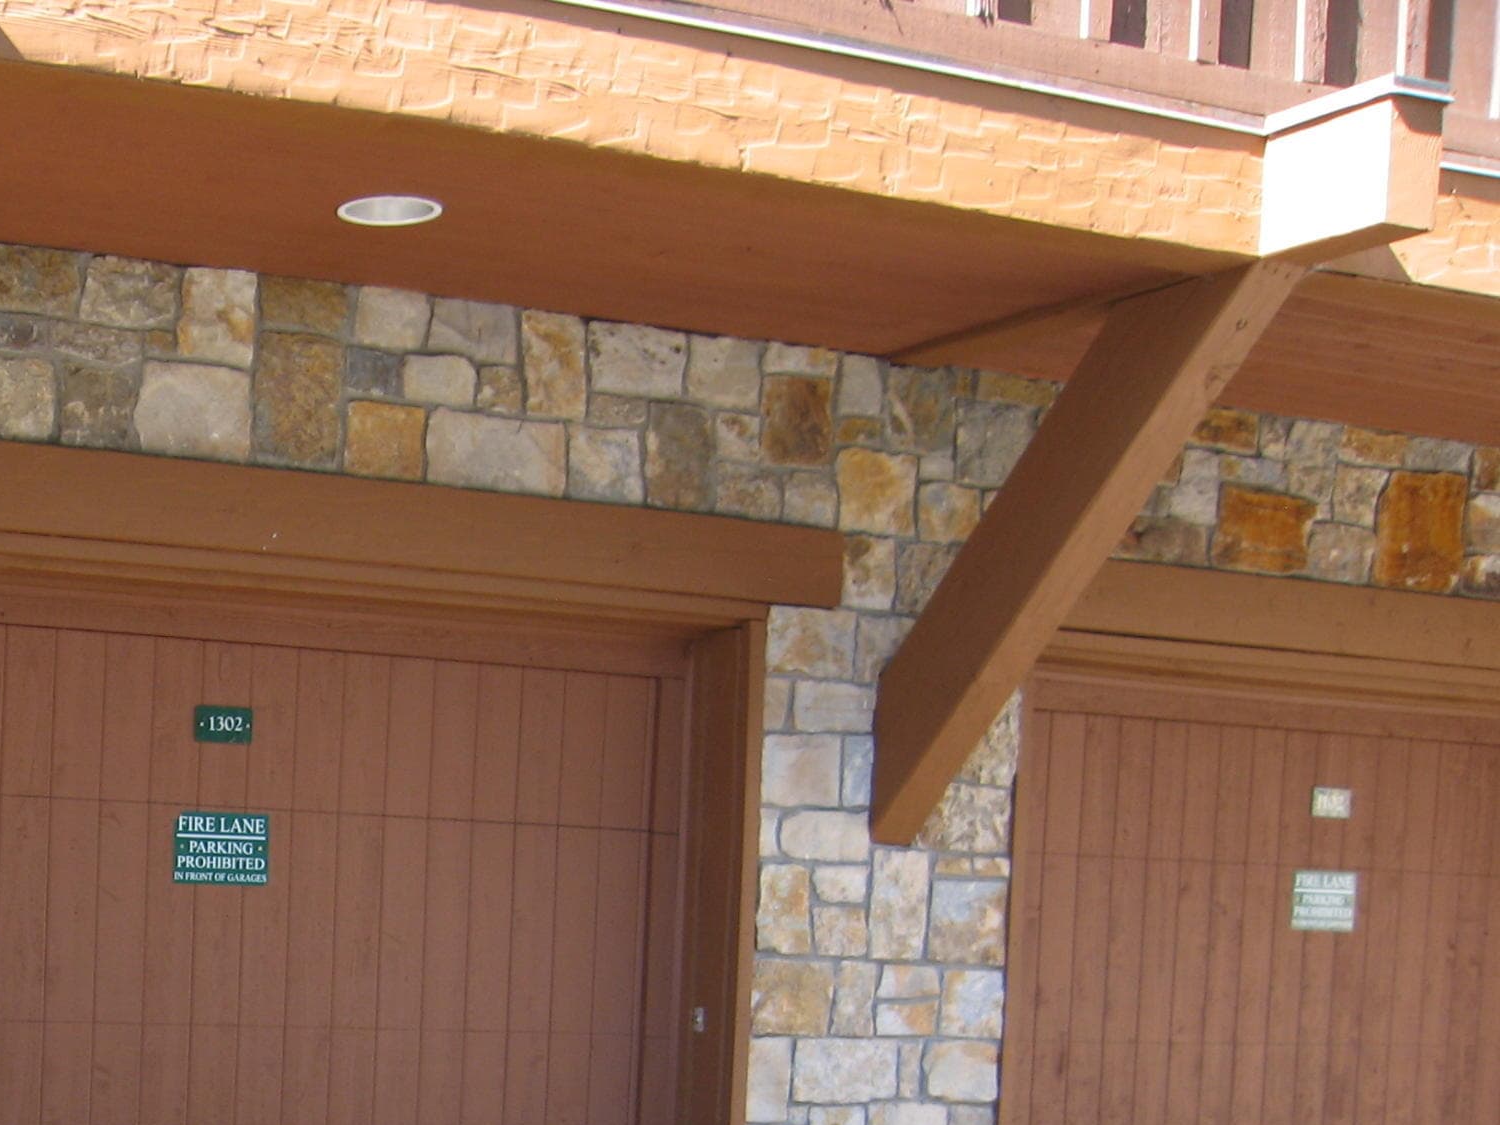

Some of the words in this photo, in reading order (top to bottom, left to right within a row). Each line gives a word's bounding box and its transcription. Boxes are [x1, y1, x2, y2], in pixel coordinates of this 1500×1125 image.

[208, 716, 243, 732] 1302
[178, 815, 216, 832] FIRE
[220, 818, 265, 834] LANE
[189, 840, 253, 855] PARKING
[177, 855, 265, 871] PROHIBITED
[174, 871, 183, 880] IN
[185, 871, 213, 881] FRONT
[214, 872, 227, 881] OF
[228, 872, 267, 883] GARAGES
[1324, 874, 1354, 889] LANE
